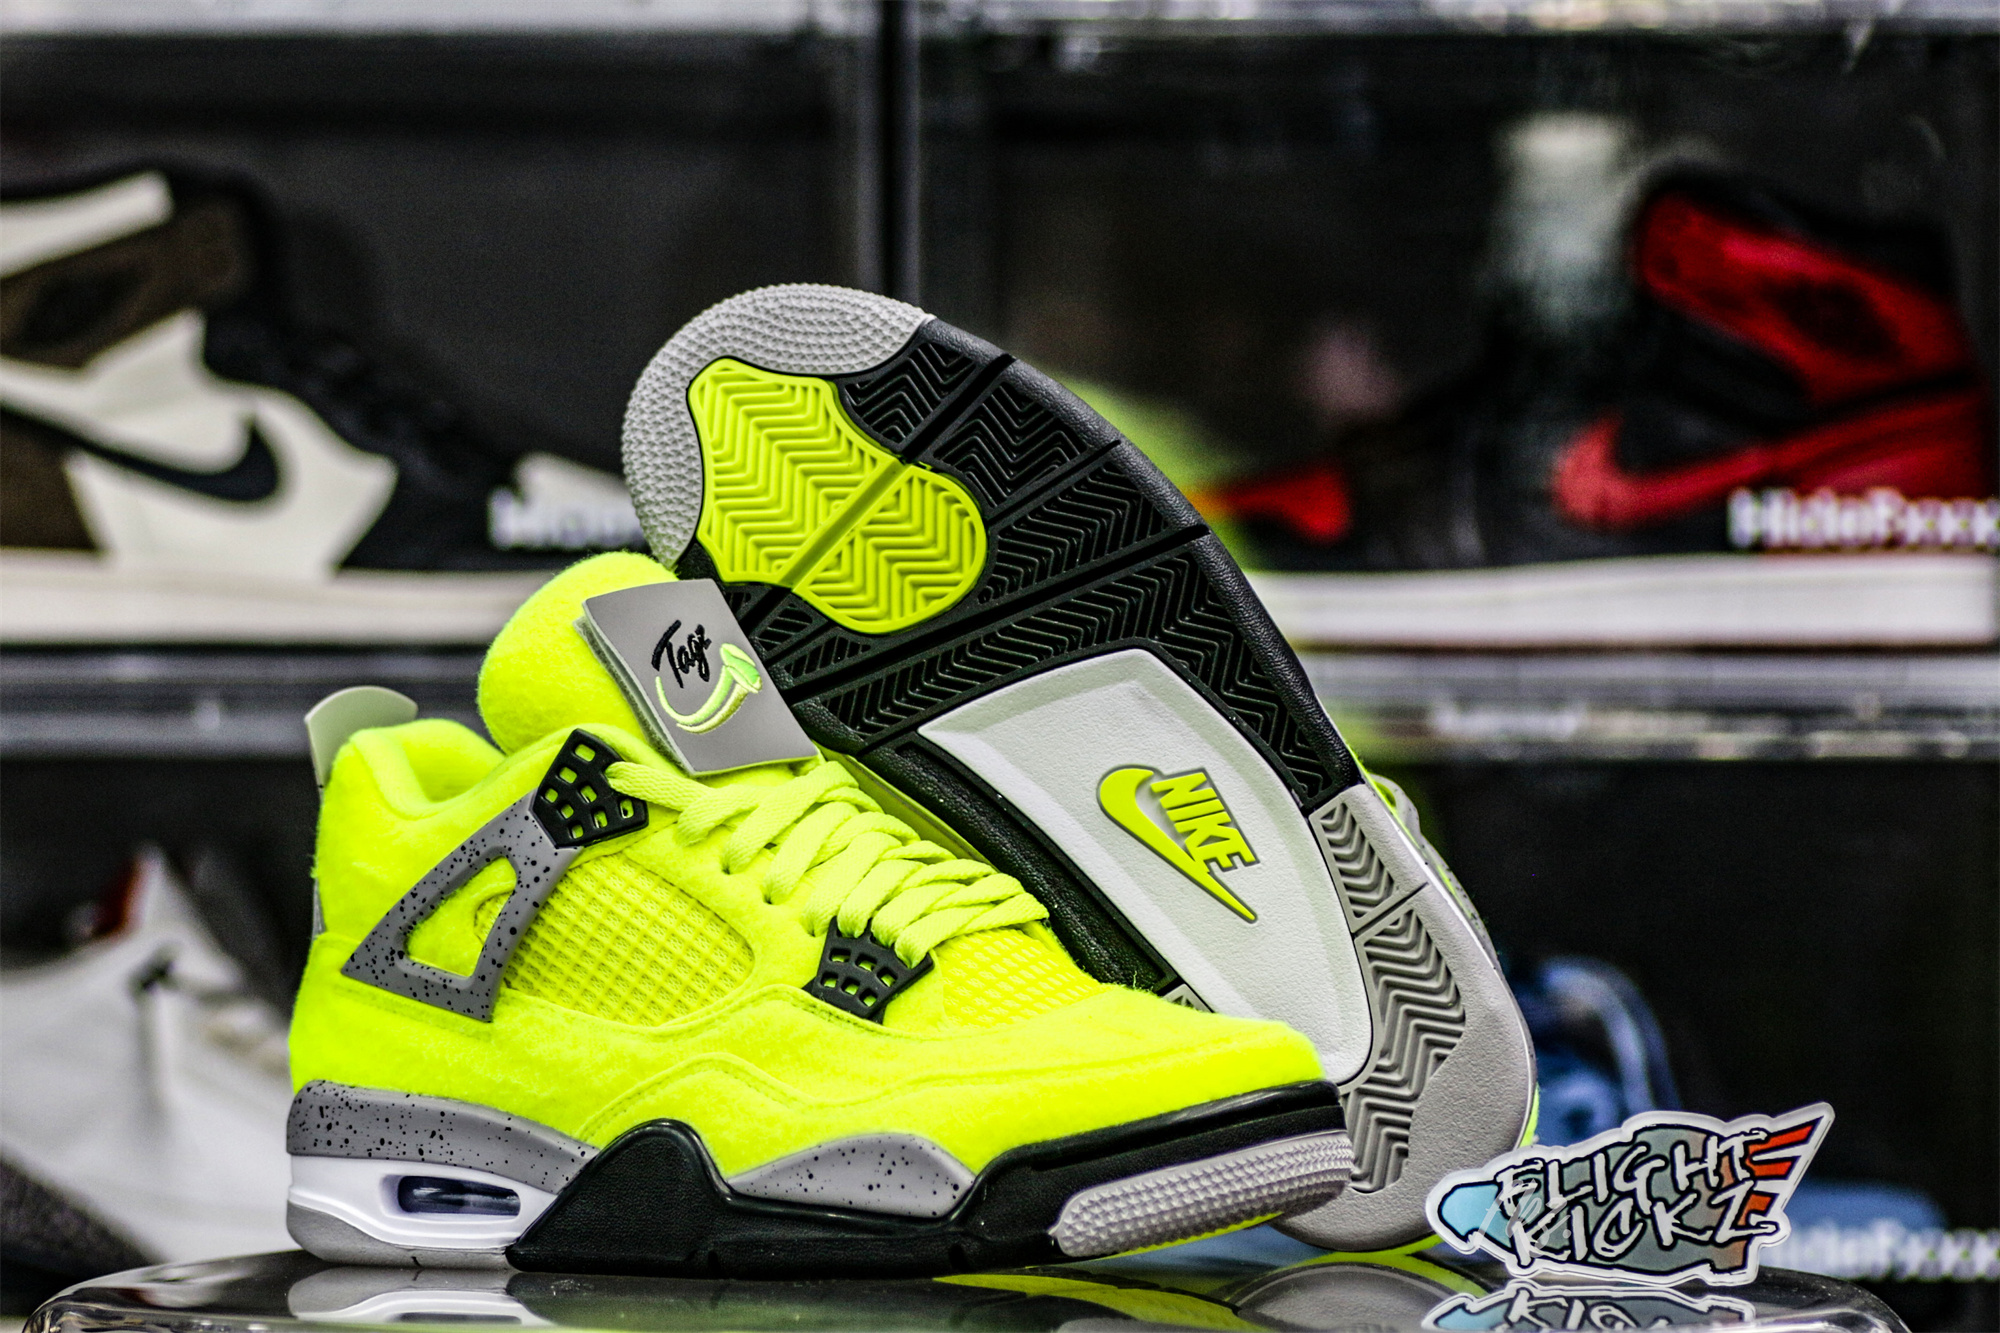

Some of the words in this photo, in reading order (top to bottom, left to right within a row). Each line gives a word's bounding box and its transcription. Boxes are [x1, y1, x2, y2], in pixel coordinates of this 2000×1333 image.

[1150, 771, 1257, 874] NIKE
[1496, 1128, 1768, 1217] FLIGHT
[1510, 1180, 1778, 1268] KICKZ
